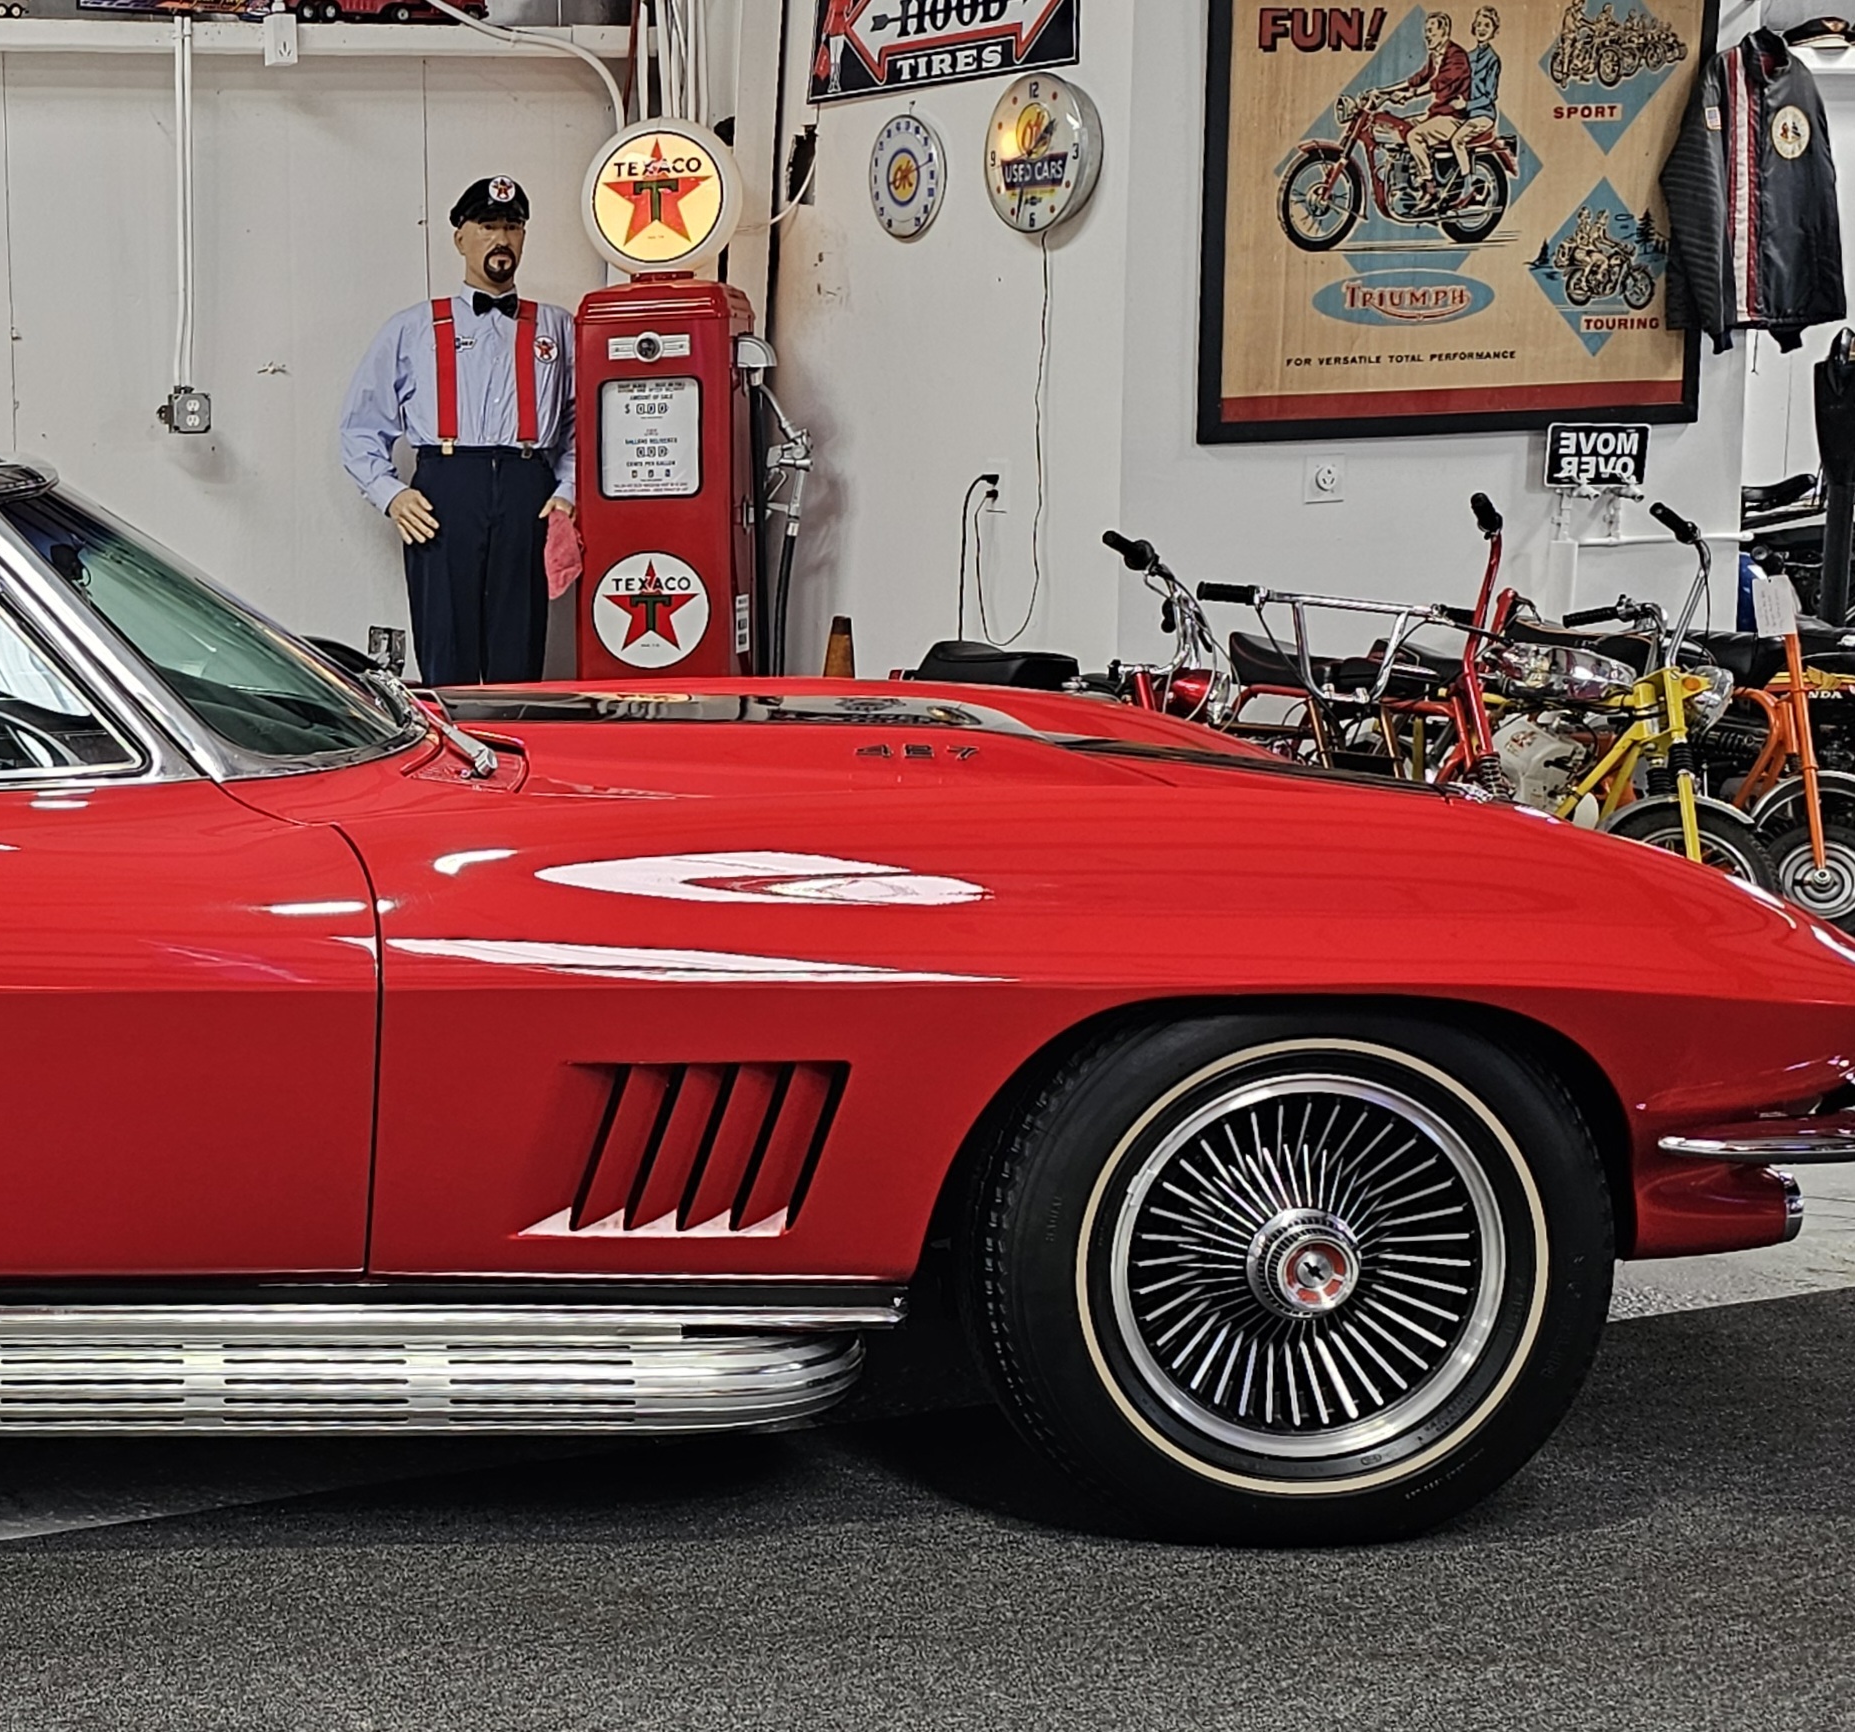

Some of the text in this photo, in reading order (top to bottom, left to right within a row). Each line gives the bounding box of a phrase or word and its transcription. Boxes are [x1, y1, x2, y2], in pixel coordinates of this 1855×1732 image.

[1258, 7, 1388, 52] FUN!
[897, 44, 1003, 80] TIRES
[1029, 81, 1039, 99] 12
[1553, 105, 1617, 120] SPORT
[990, 150, 996, 167] 9
[1072, 143, 1079, 160] 3
[614, 157, 702, 177] TEXACO
[1004, 159, 1064, 183] USED CARS
[1029, 212, 1035, 228] 6
[1343, 281, 1470, 310] TRIUMPH
[1584, 317, 1660, 330] TOURING
[1286, 350, 1516, 367] FOR VERSATILE TOTAL PERFORMANCE
[612, 576, 691, 592] TEXACO
[854, 743, 980, 760] 427
